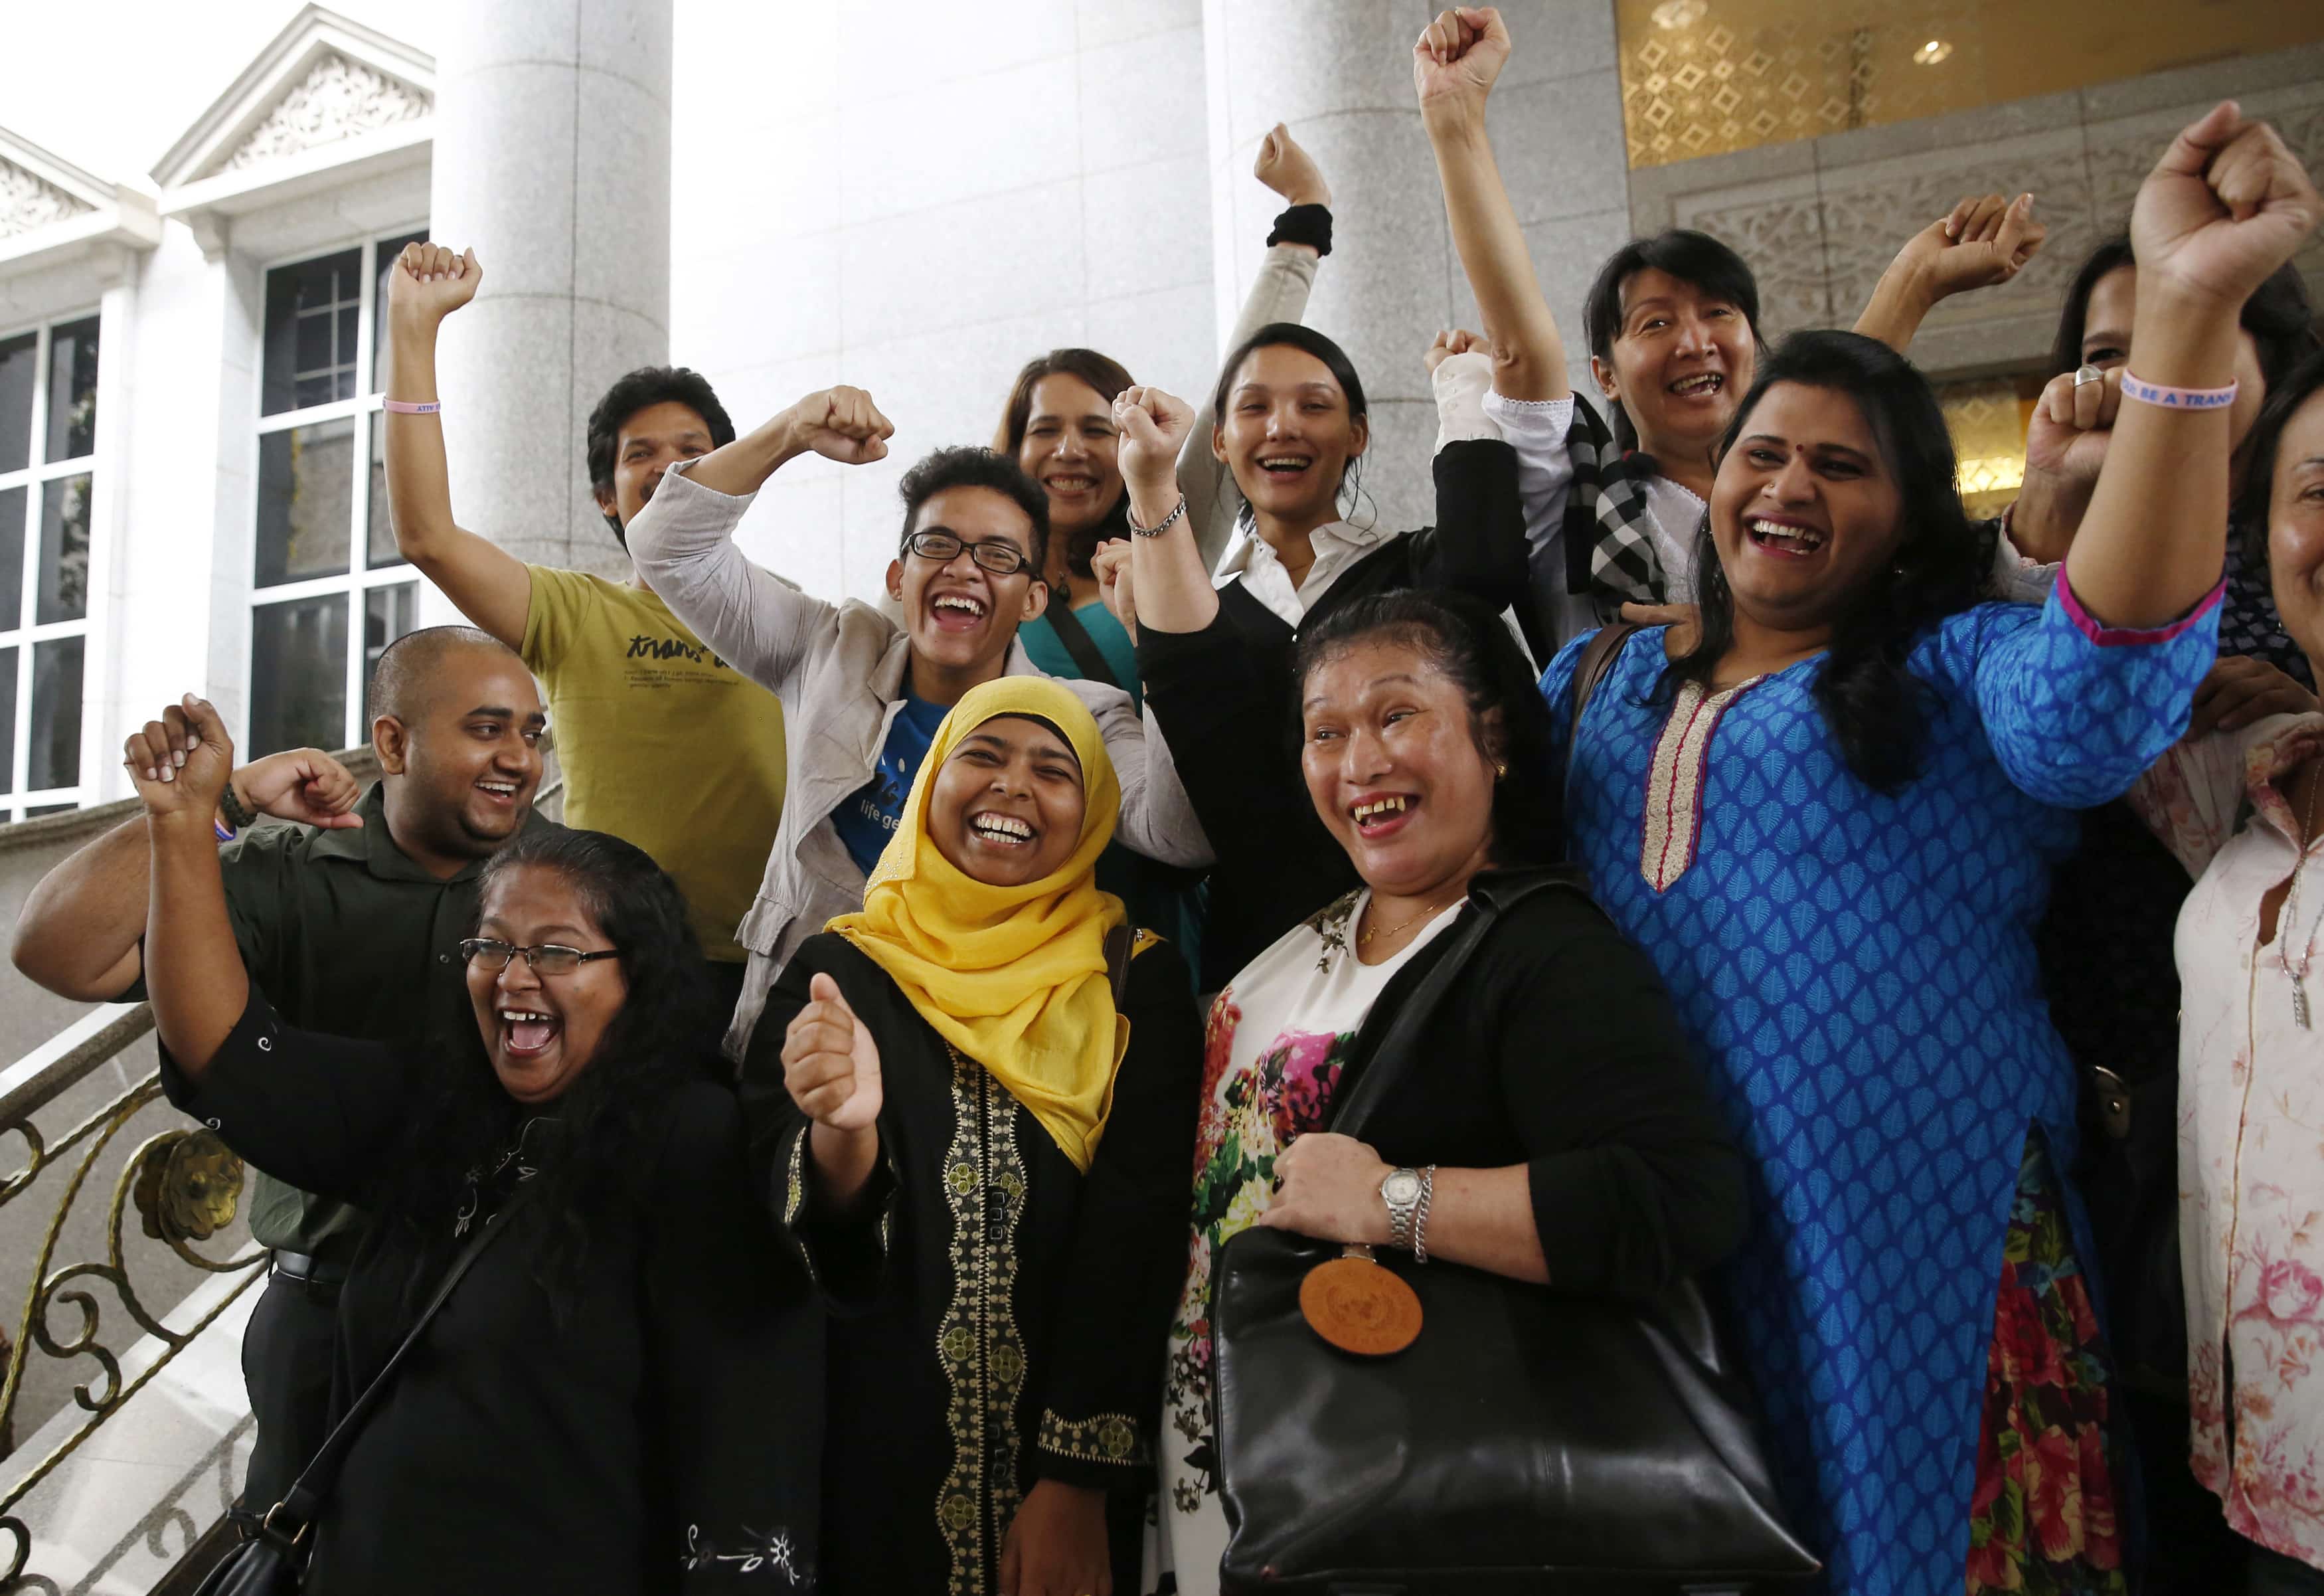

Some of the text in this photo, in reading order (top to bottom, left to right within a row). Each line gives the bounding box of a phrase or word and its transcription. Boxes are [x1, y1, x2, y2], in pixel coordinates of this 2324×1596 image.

[2140, 387, 2157, 400] BE
[2163, 393, 2178, 404] A
[861, 799, 901, 830] life ge
